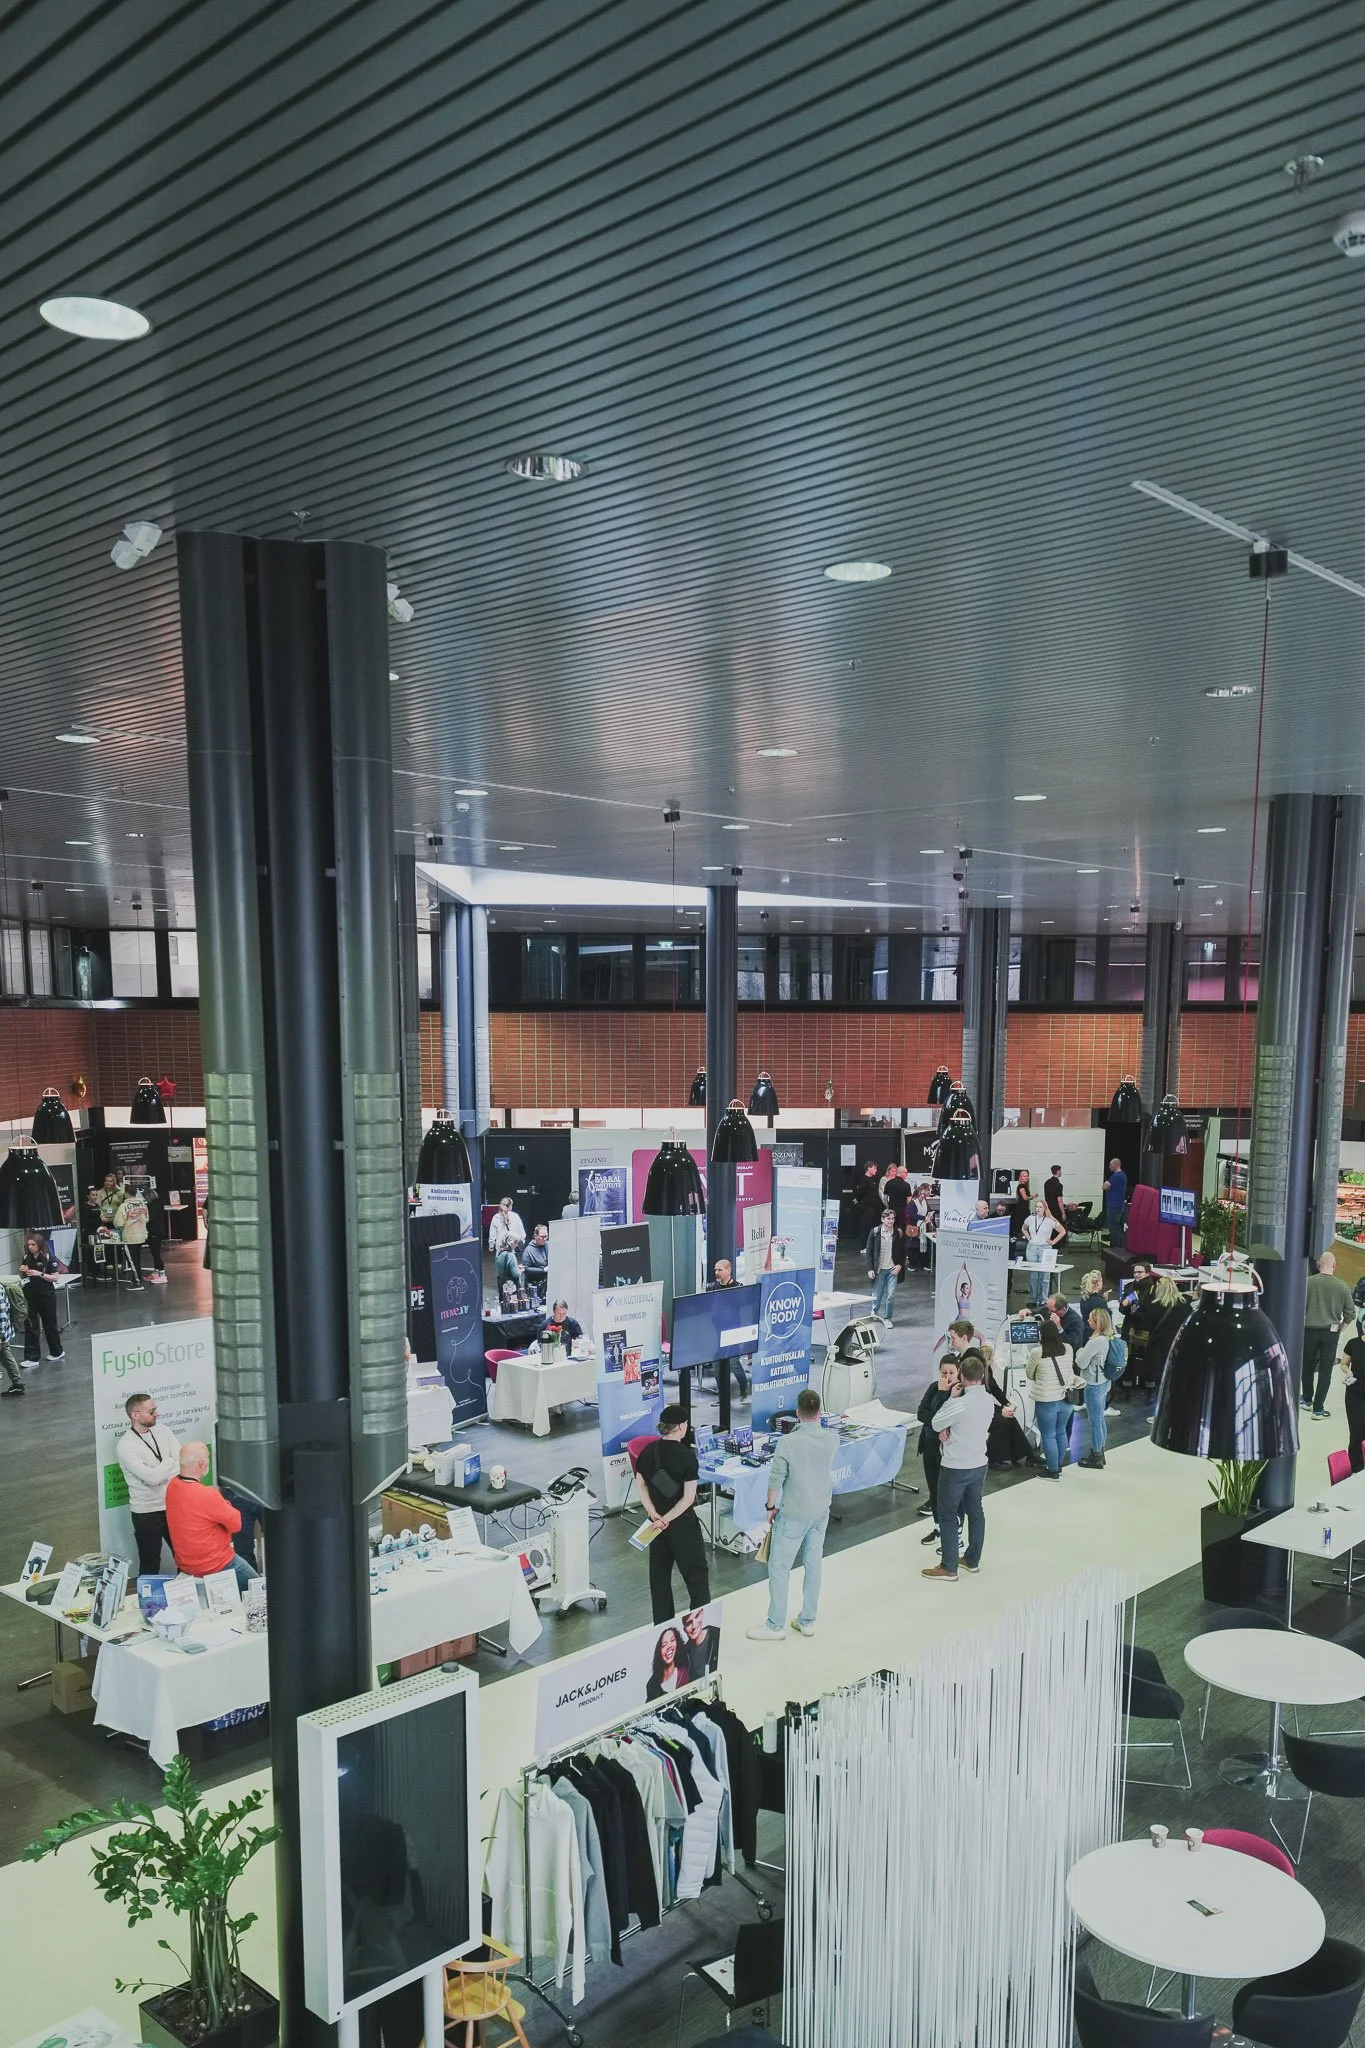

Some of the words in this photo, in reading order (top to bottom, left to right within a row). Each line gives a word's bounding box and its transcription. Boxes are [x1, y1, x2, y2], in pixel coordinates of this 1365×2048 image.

[972, 1243, 1003, 1252] INFINITY
[769, 1296, 802, 1313] KNOW
[771, 1308, 800, 1325] BODY
[102, 1342, 205, 1378] FysioStore
[760, 1349, 806, 1367] KUNTOUTUSALAN
[754, 1373, 808, 1393] KOULUTUSPORTAALI
[555, 1667, 628, 1709] JACK&JONES
